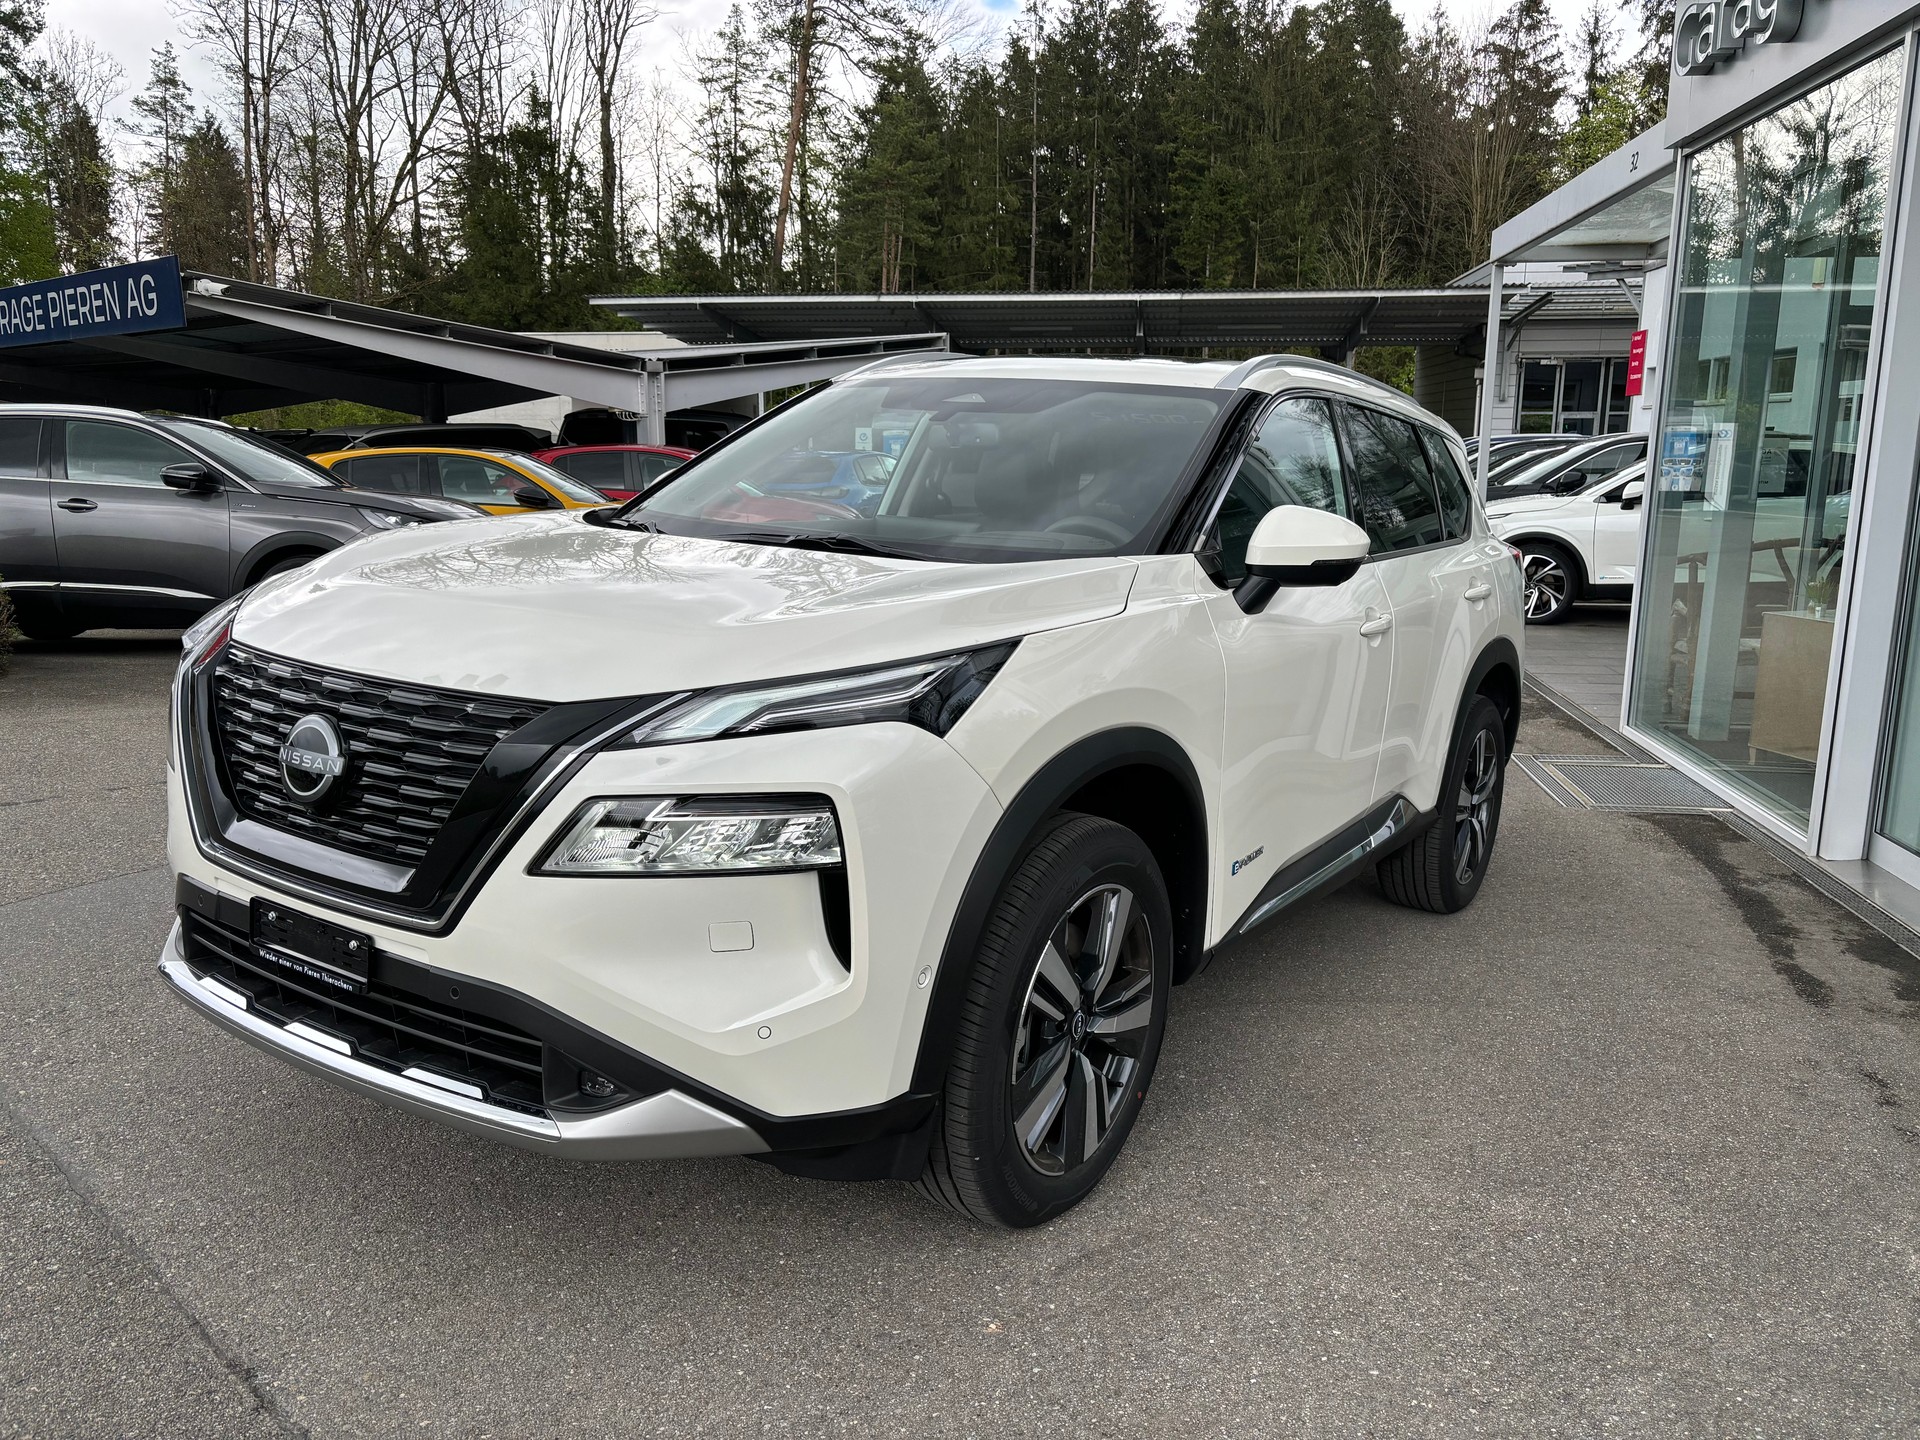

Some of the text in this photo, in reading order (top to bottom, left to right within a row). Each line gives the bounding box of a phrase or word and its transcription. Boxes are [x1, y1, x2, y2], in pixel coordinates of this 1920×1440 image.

[1630, 151, 1639, 173] 32
[47, 281, 121, 328] PIEREN
[127, 273, 158, 319] AG
[280, 746, 341, 773] NISSAN
[259, 949, 353, 992] Wieder einer von Pieren Thierachern
